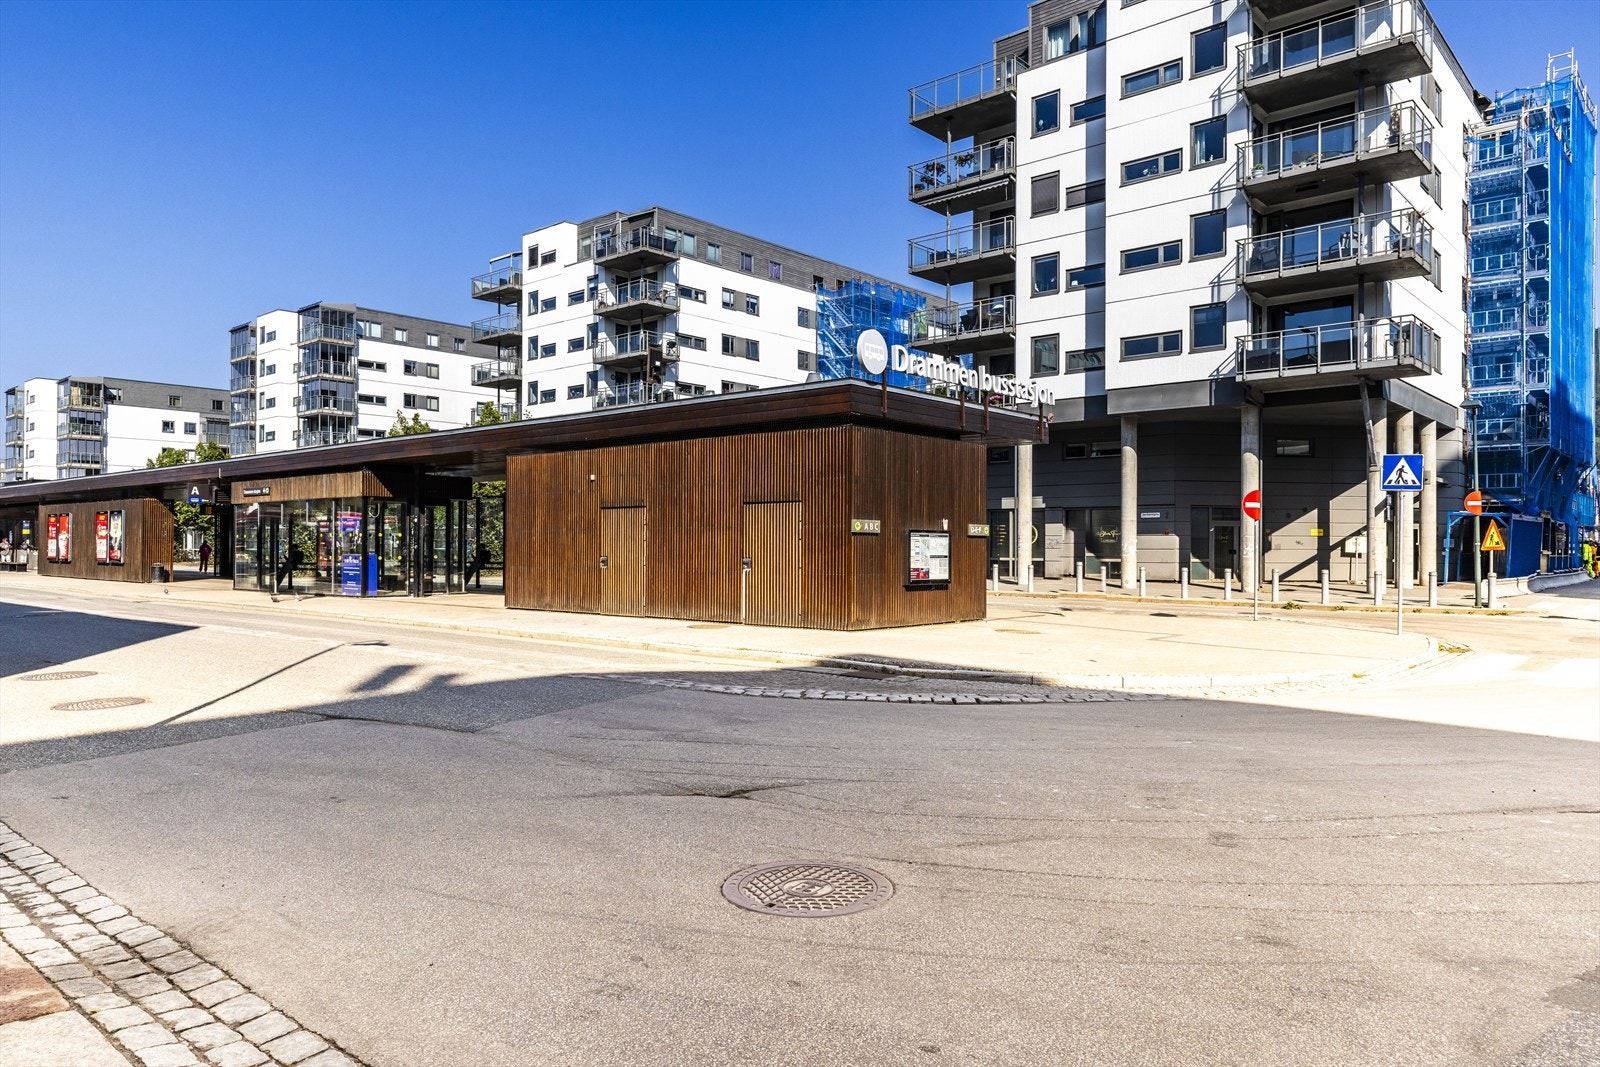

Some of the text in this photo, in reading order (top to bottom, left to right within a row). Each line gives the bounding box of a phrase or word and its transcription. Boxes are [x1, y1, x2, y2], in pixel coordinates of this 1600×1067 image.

[891, 344, 1056, 408] Drammen busstasjon
[191, 486, 199, 495] A
